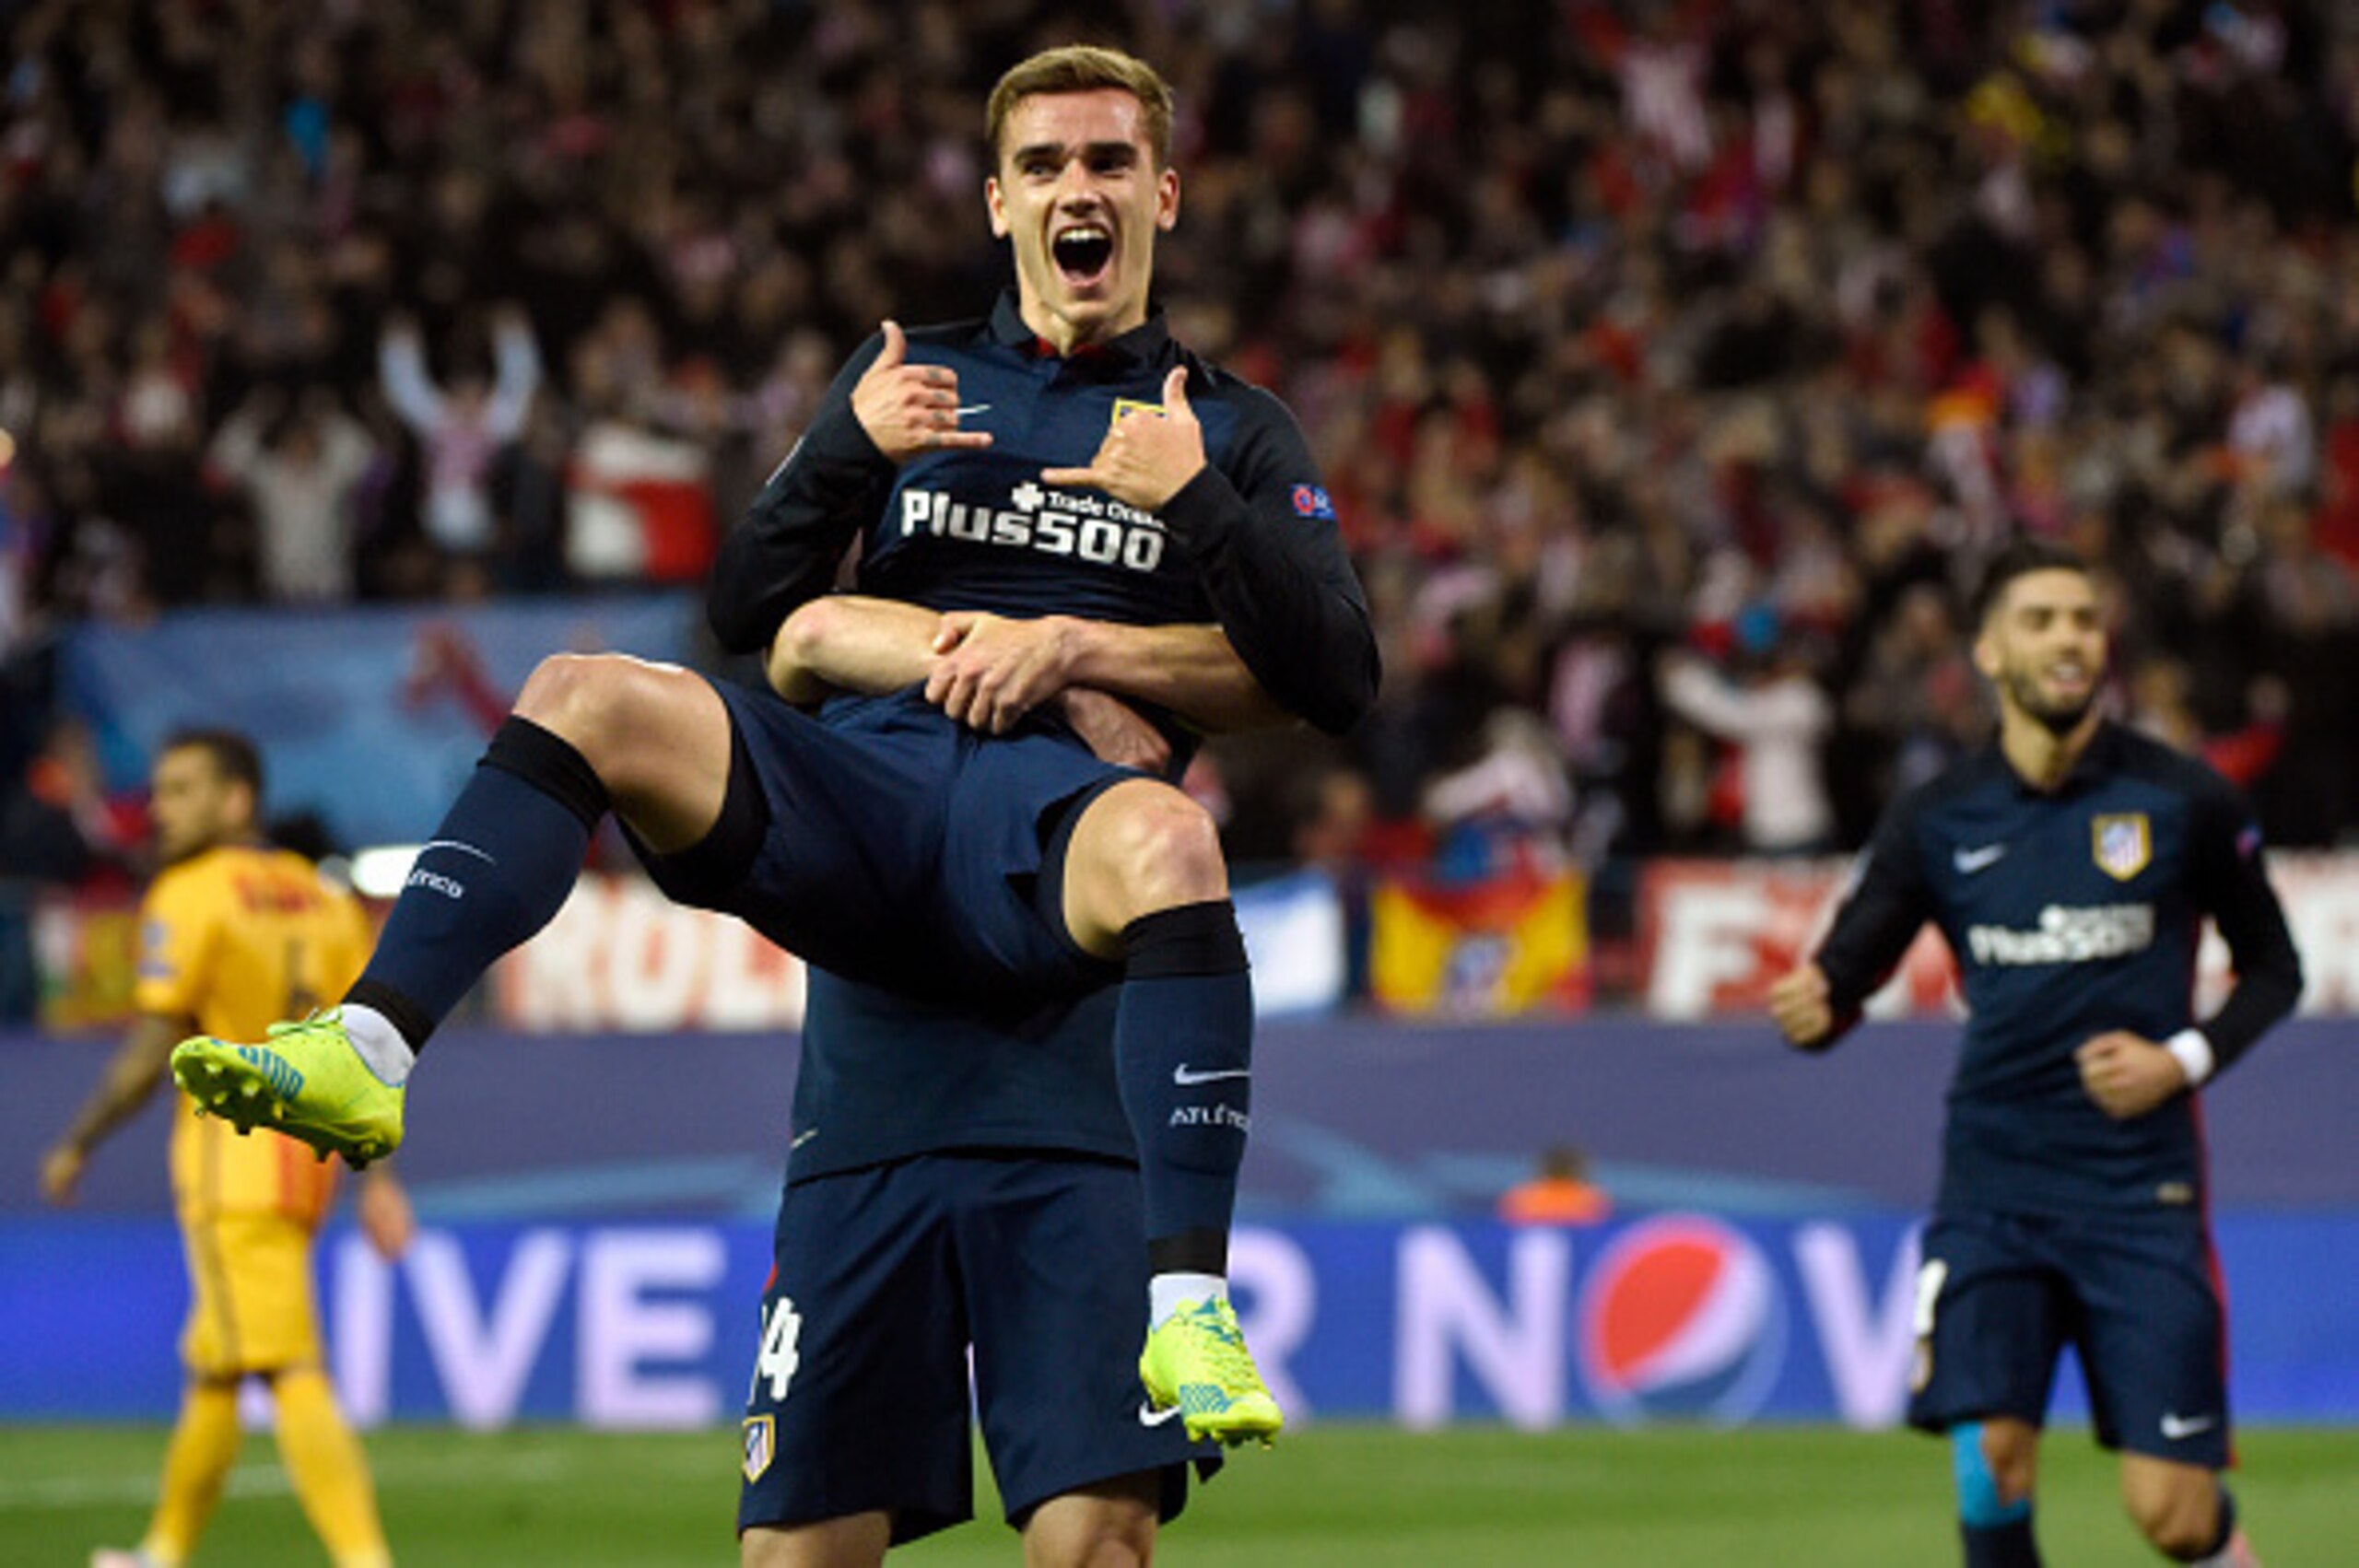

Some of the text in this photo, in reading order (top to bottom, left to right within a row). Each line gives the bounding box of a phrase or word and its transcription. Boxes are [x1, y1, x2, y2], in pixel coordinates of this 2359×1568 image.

[901, 487, 1166, 573] Plus500
[1047, 490, 1105, 517] Trade
[238, 1225, 726, 1433] IVE
